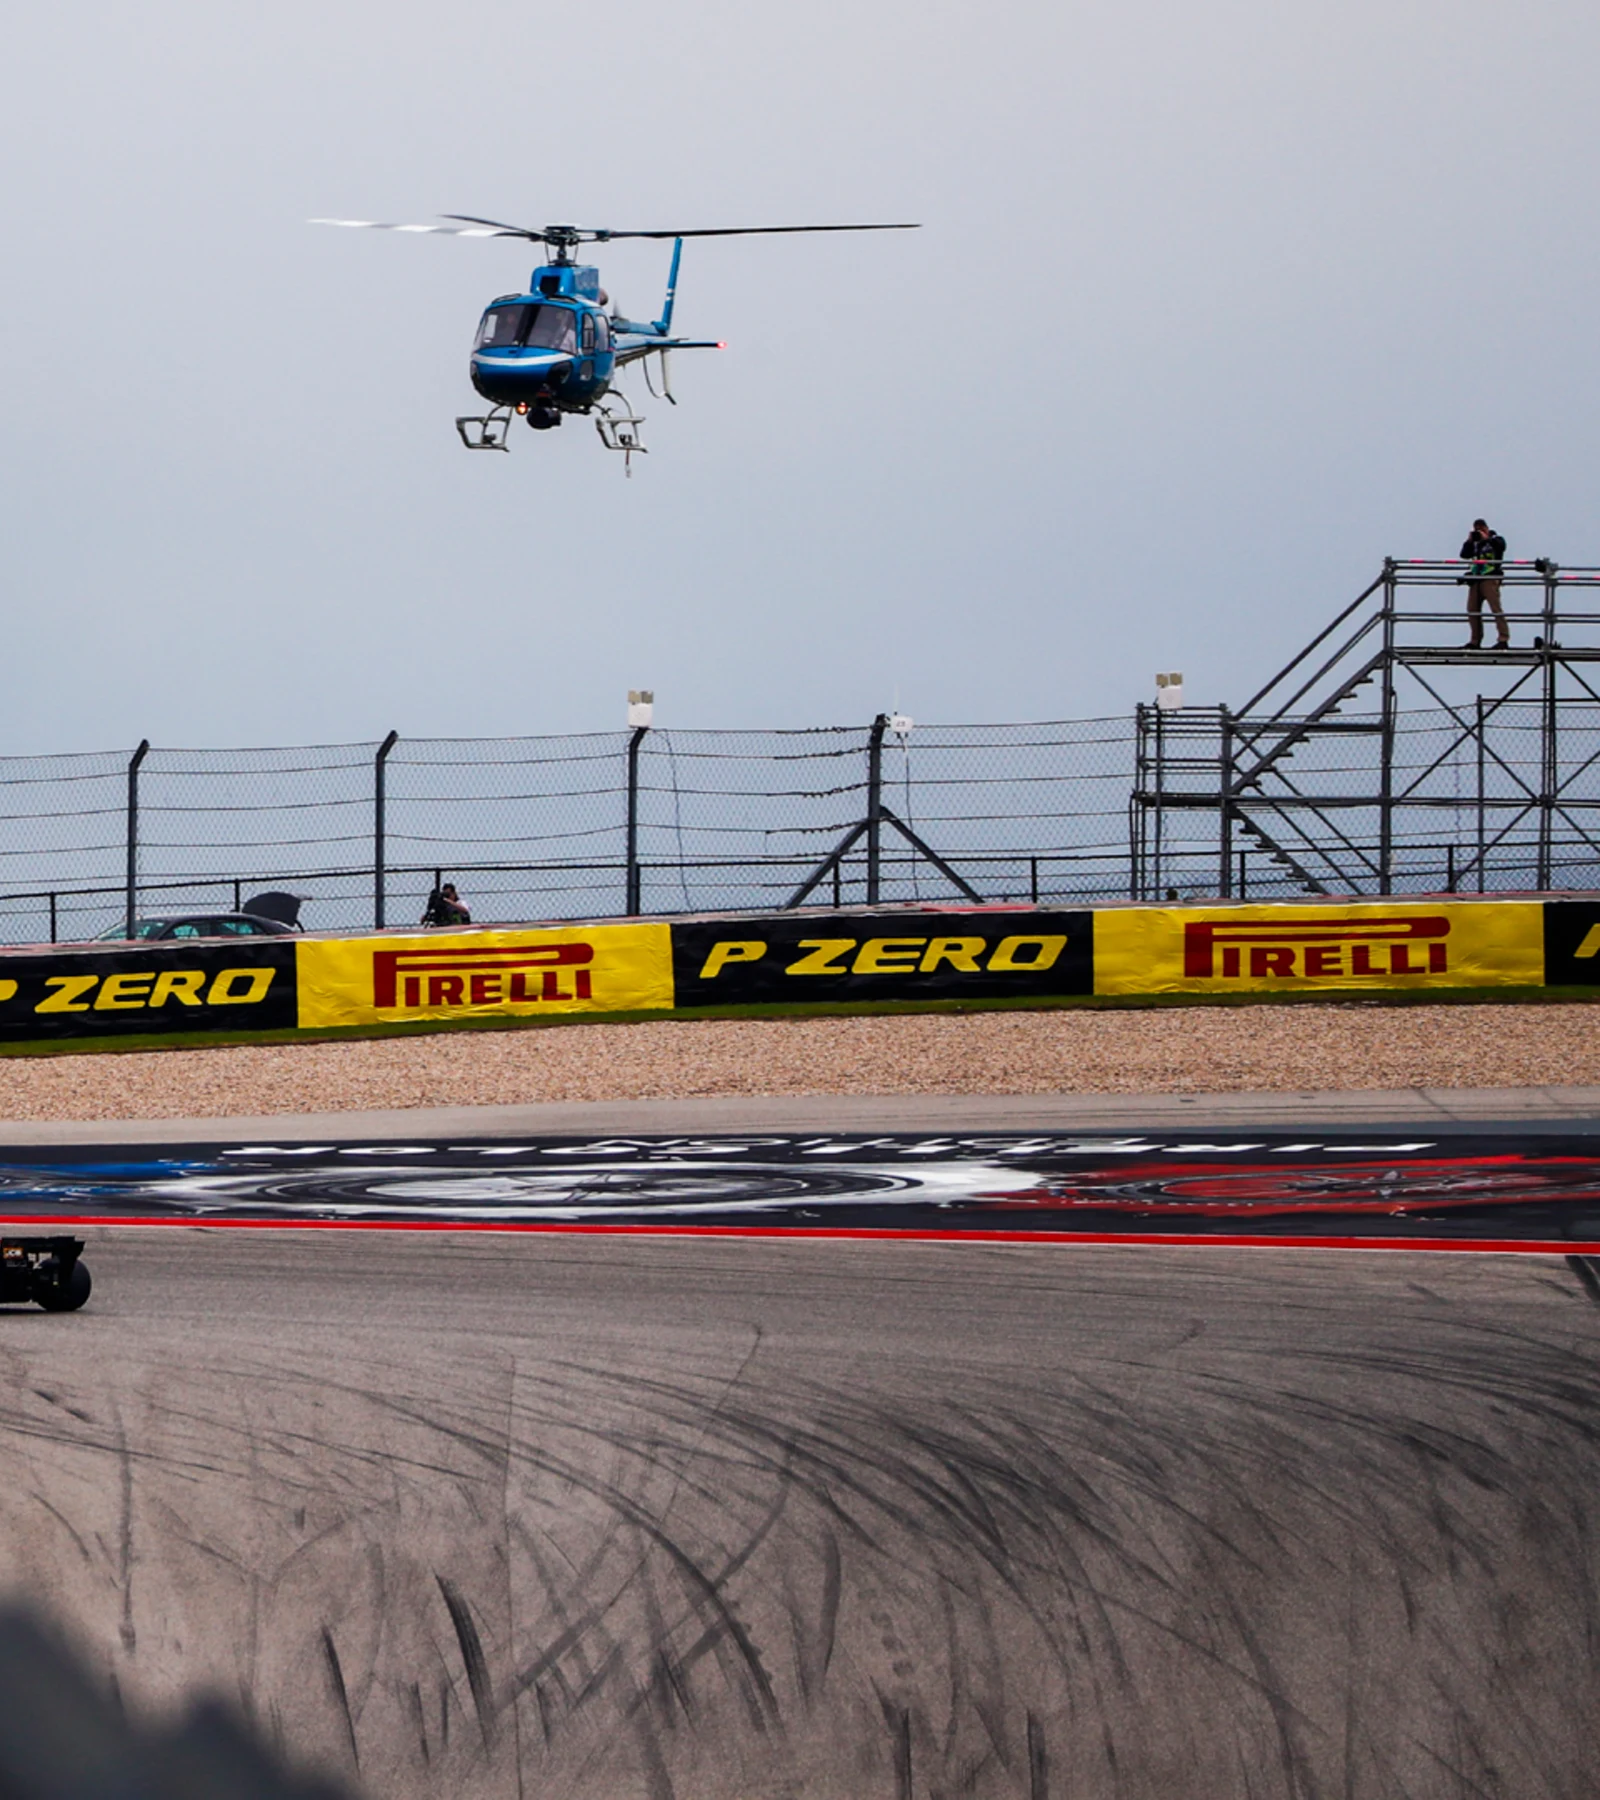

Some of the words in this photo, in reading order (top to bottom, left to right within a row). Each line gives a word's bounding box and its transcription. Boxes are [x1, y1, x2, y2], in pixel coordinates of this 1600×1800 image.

[699, 941, 767, 979] P
[786, 935, 1068, 976] ZERO
[1184, 917, 1451, 978] PIRELLI
[34, 968, 276, 1014] ZERO
[372, 942, 594, 1008] PIRELLI
